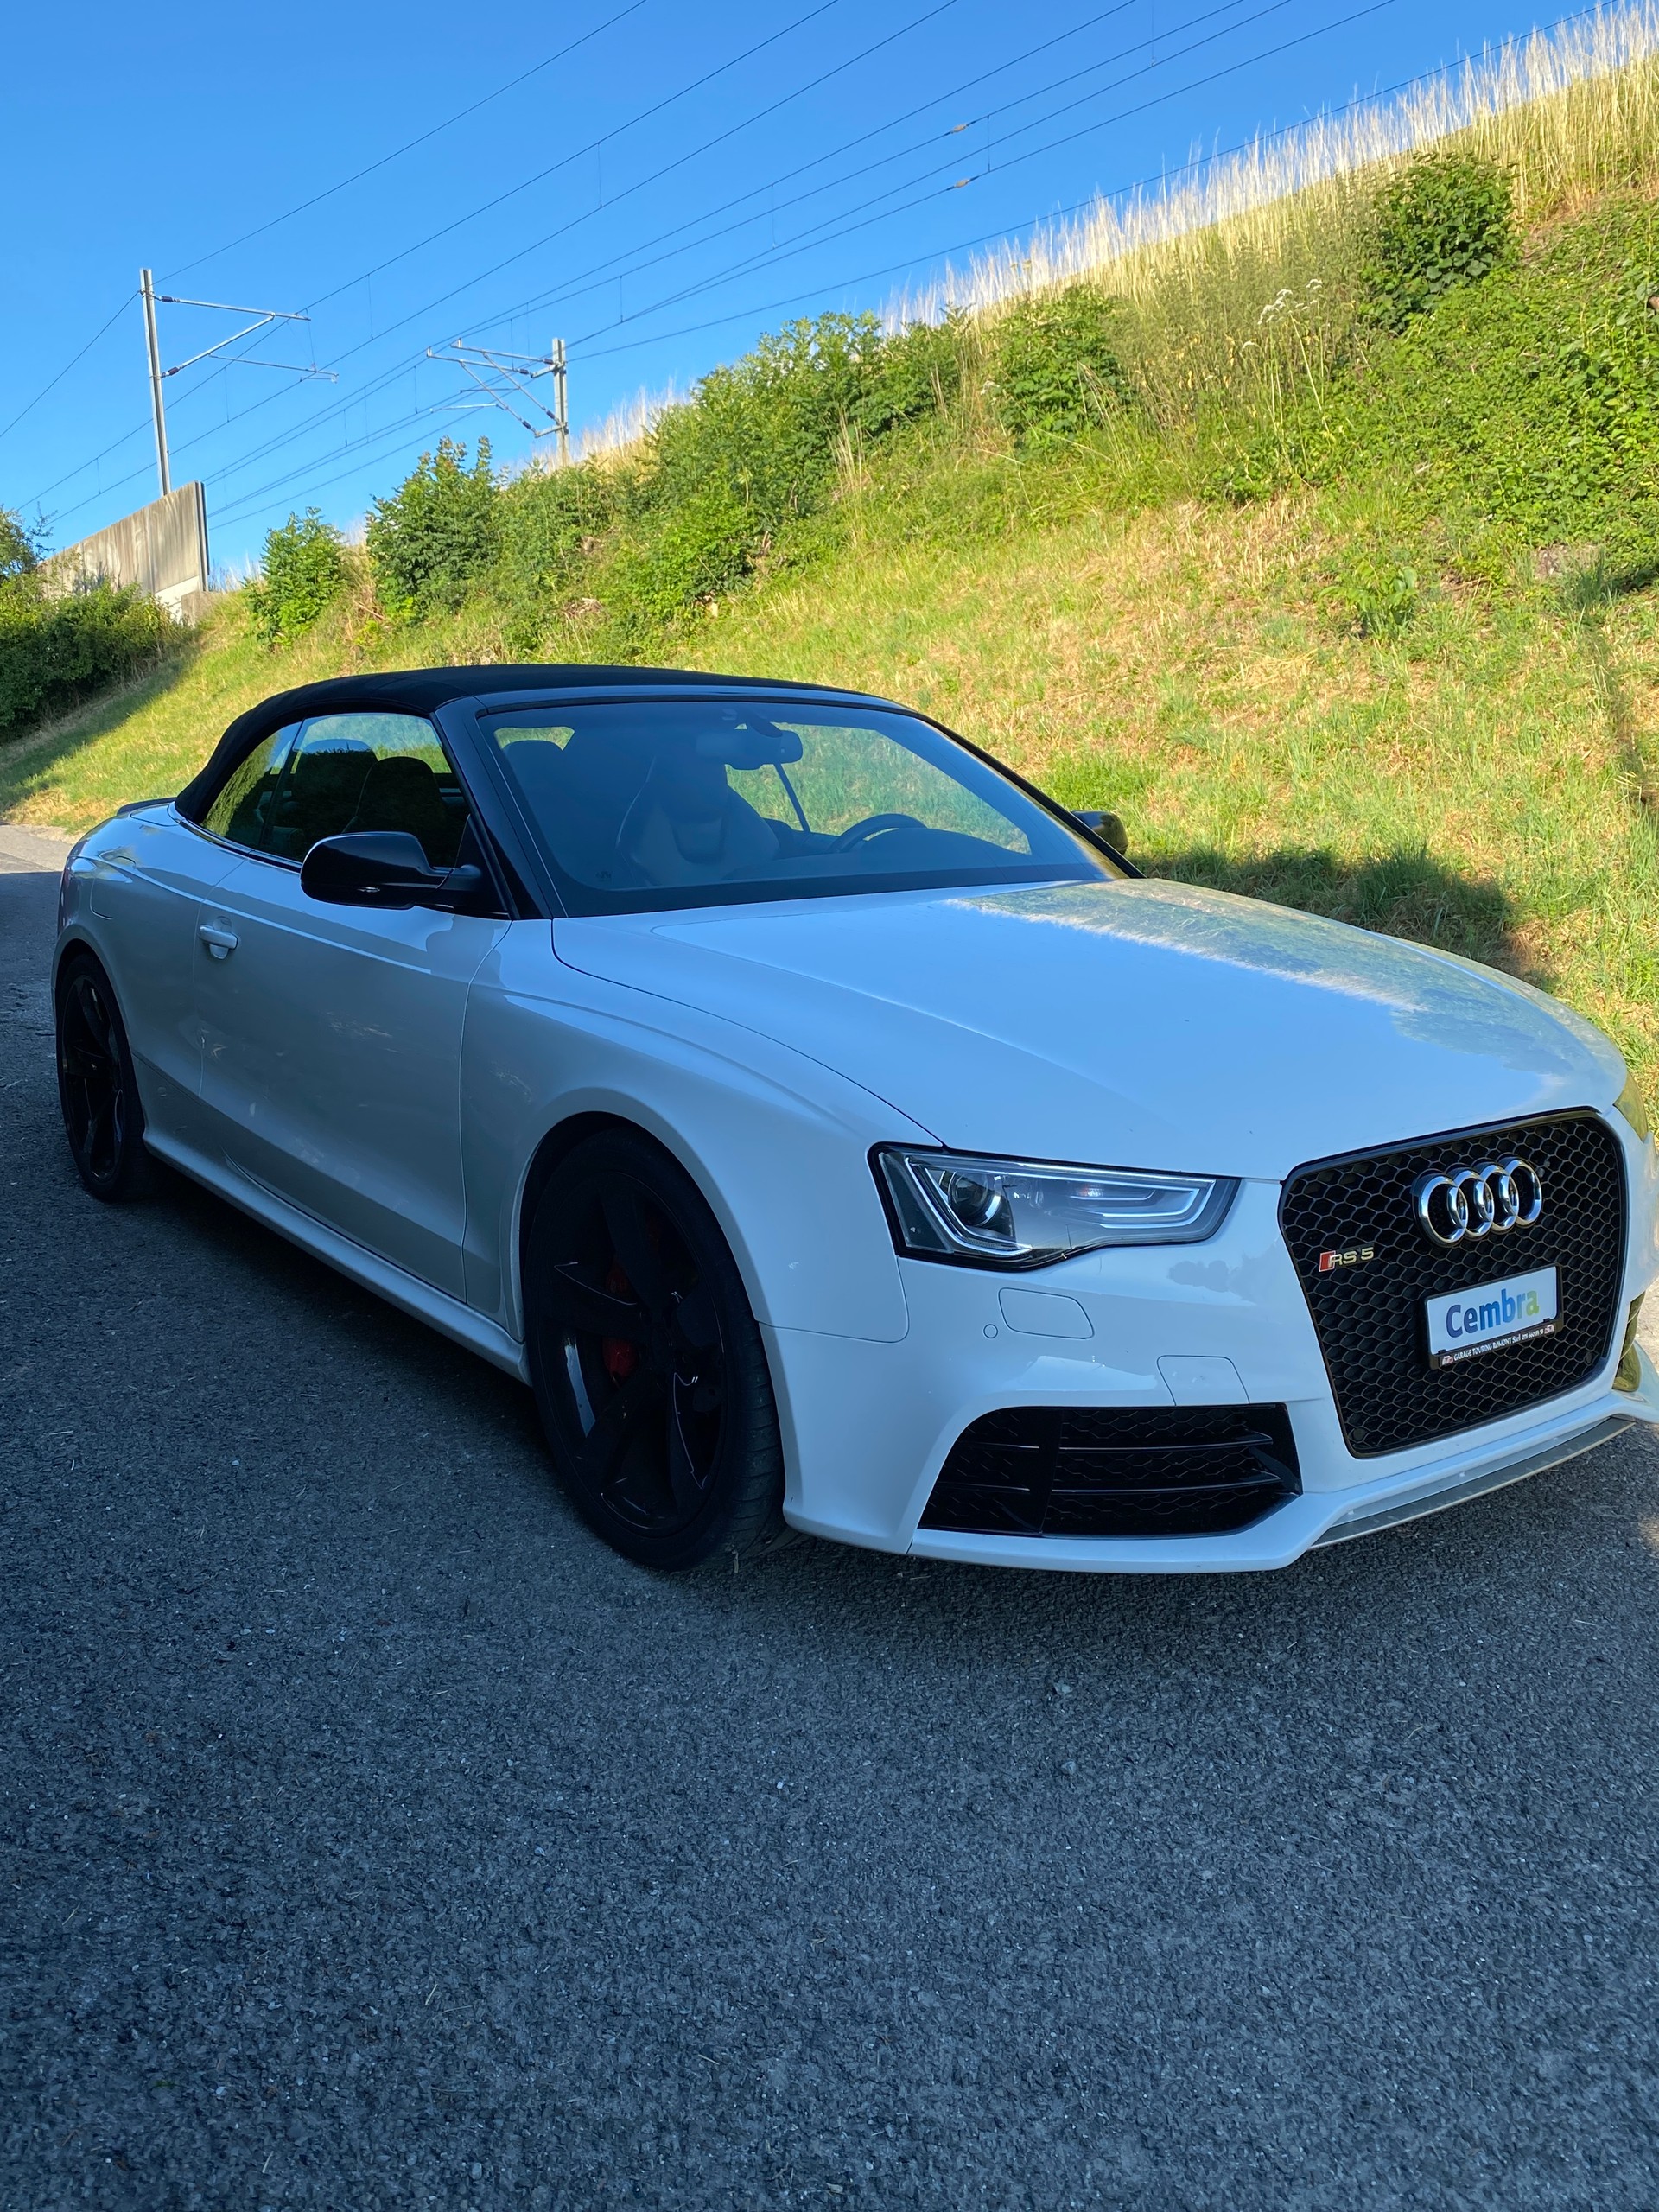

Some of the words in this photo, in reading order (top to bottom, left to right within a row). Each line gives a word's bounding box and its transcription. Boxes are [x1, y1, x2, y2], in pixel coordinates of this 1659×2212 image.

[1327, 1251, 1357, 1268] RS
[1361, 1247, 1374, 1260] 5
[1446, 1288, 1539, 1338] Cembra
[1453, 1349, 1472, 1361] GARAGE
